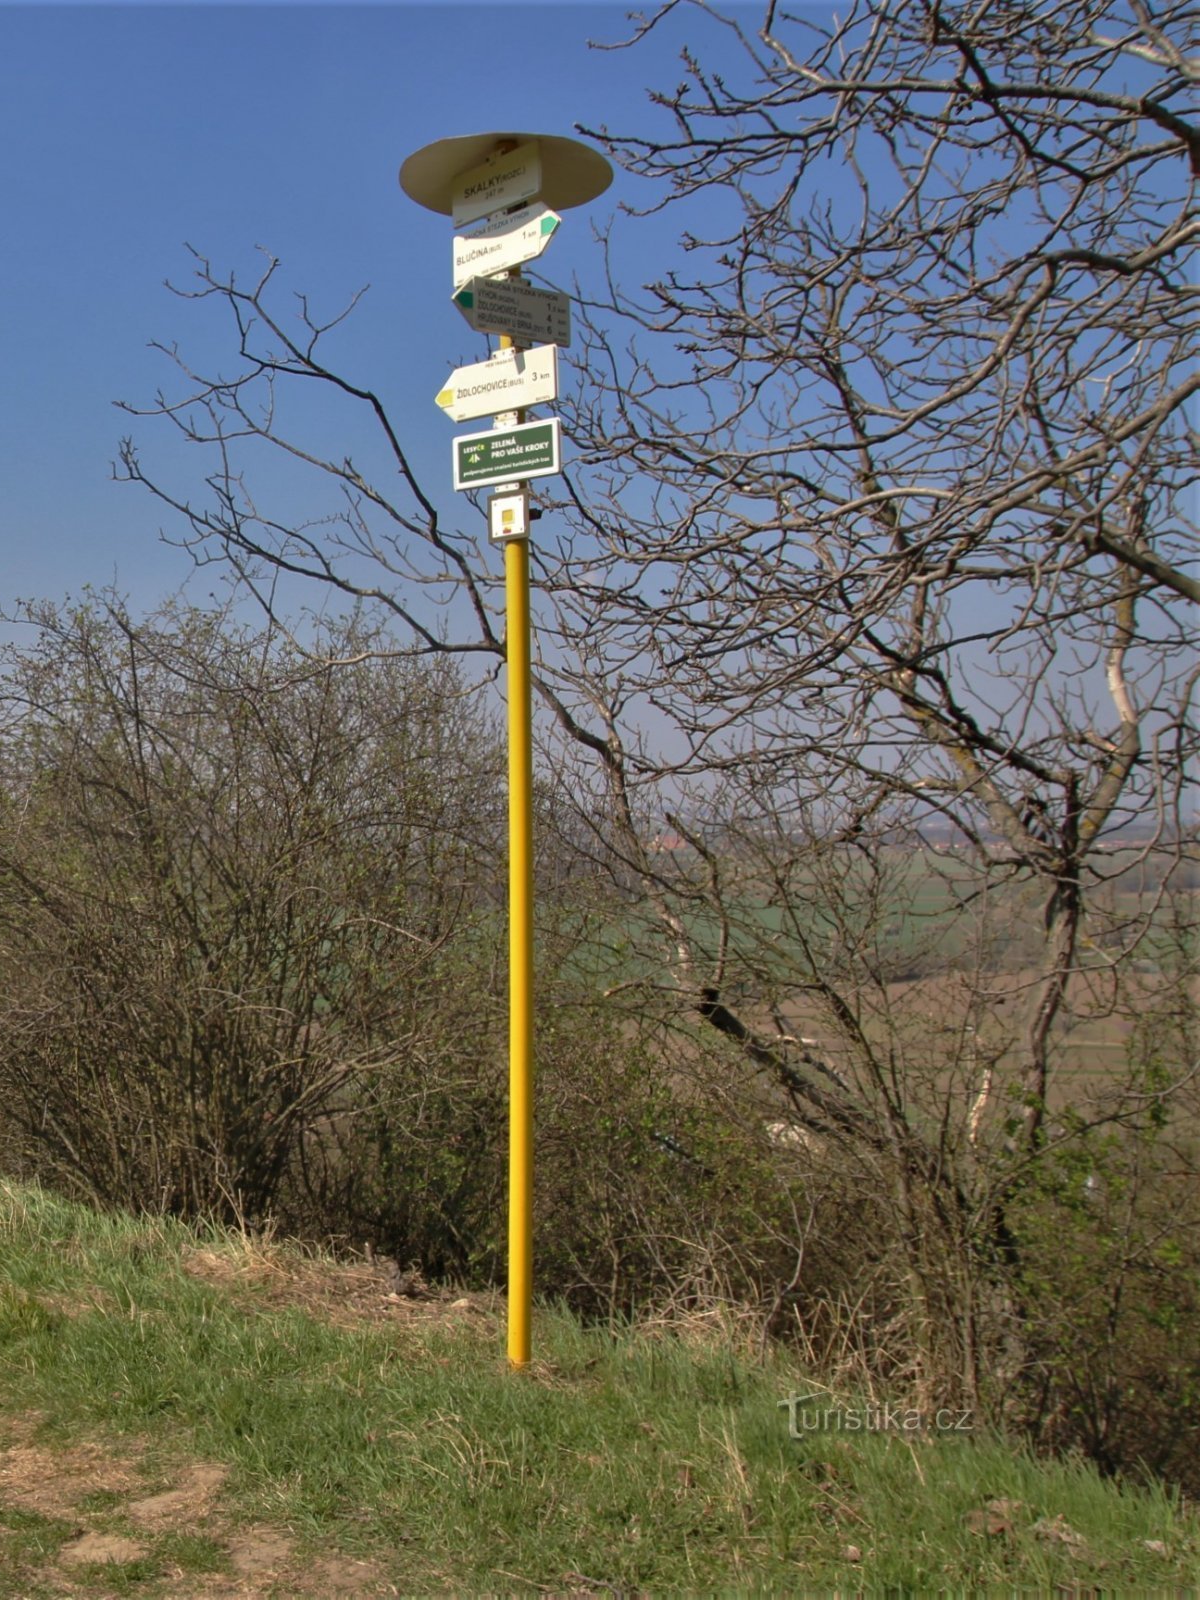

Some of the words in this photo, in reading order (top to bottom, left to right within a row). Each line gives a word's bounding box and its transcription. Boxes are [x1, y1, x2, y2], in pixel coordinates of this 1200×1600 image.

[487, 218, 509, 232] STEZKA
[522, 230, 527, 240] 1
[546, 314, 552, 323] 4
[546, 325, 552, 335] 6
[531, 372, 538, 382] 3
[540, 372, 550, 380] km
[491, 436, 516, 450] ZELENÁ
[491, 449, 506, 459] PRO
[507, 445, 524, 456] VAŠE
[525, 441, 550, 453] KROKY
